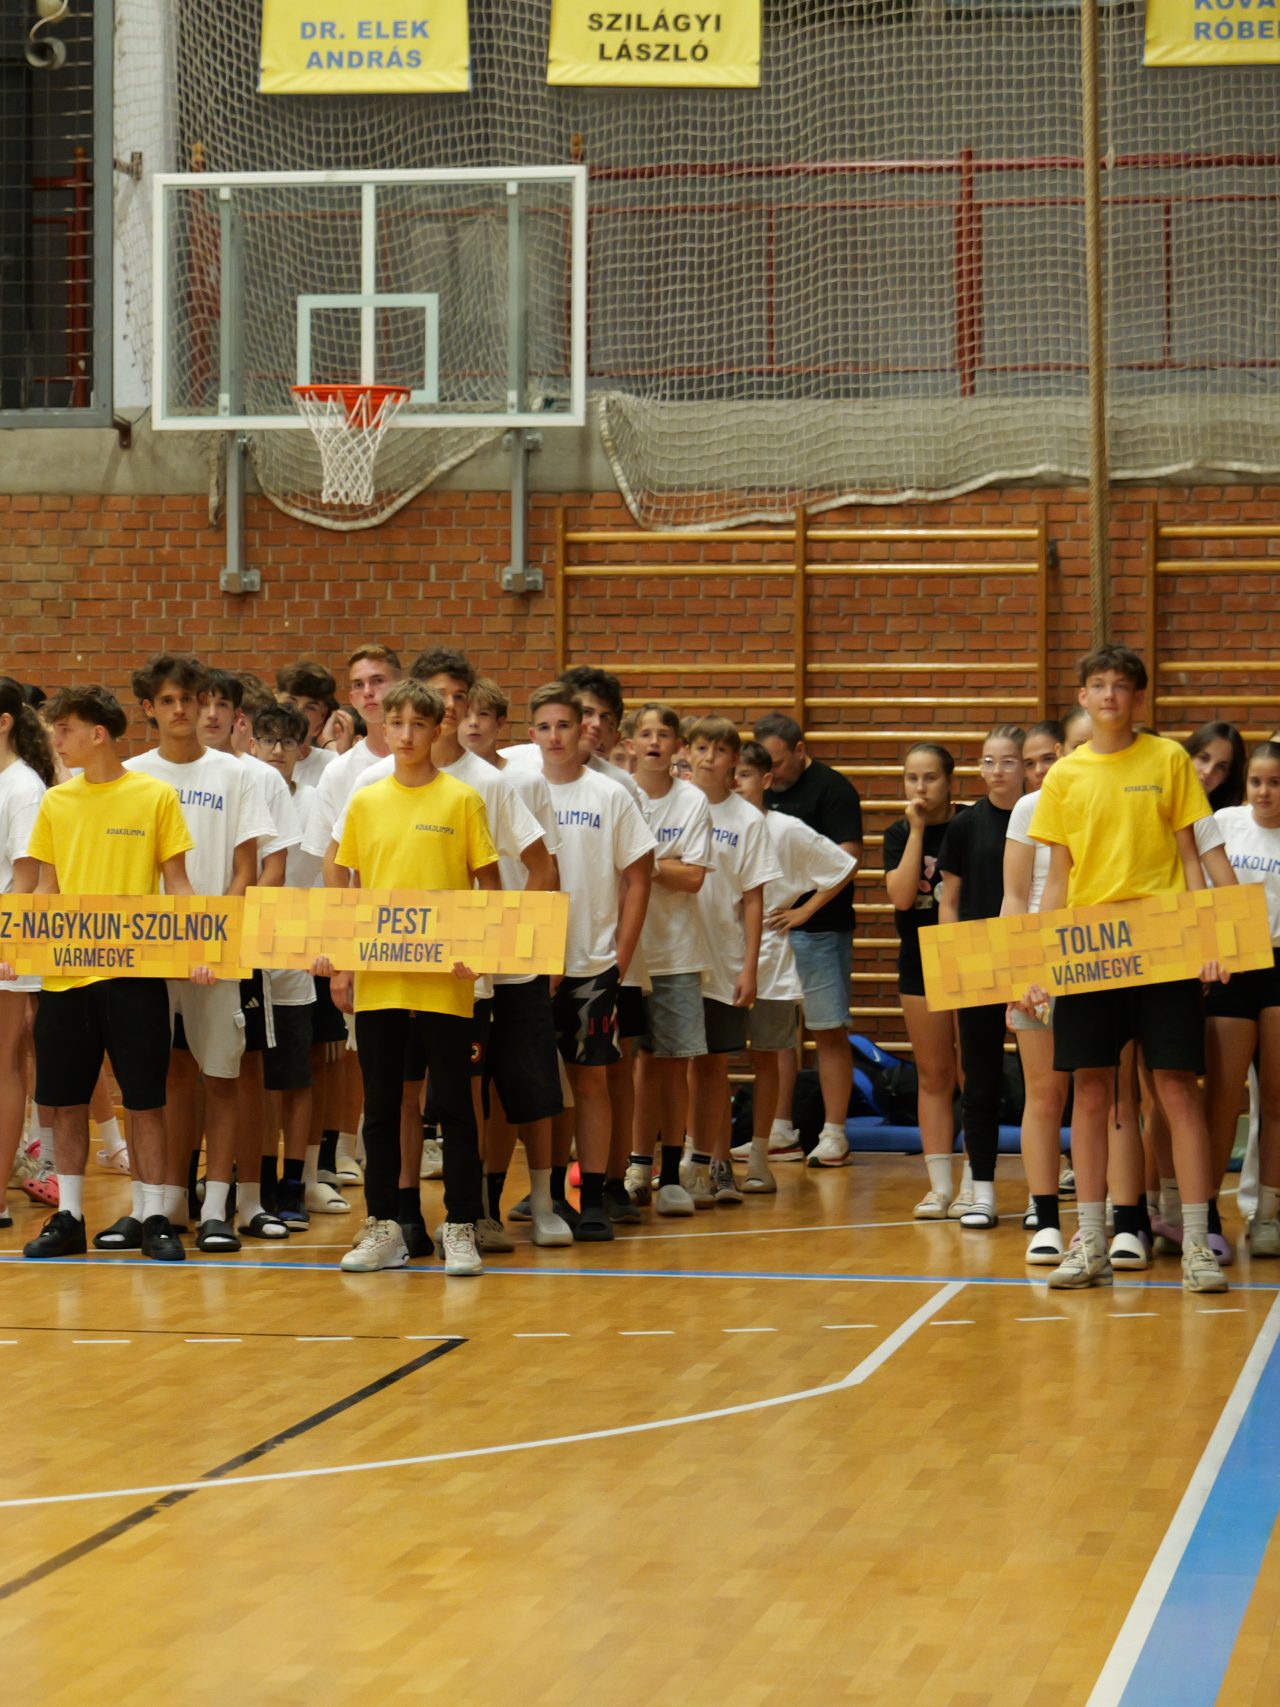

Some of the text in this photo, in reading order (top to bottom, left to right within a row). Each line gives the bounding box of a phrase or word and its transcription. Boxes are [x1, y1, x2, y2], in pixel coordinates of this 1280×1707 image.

[300, 20, 429, 40] DR. ELEK
[588, 9, 722, 32] SZILÁGYI
[1194, 17, 1280, 41] RÓBE
[306, 45, 422, 69] ANDRÁS
[599, 38, 709, 62] LÁSZLÓ
[175, 789, 223, 811] LIMPIA
[554, 811, 600, 828] LIMPIA
[377, 907, 432, 935] PEST
[1055, 920, 1133, 956] TOLNA
[53, 944, 135, 968] VÁRMEGYE
[359, 939, 443, 963] VÁRMEGYE
[1051, 955, 1143, 986] VÁRMEGYE
